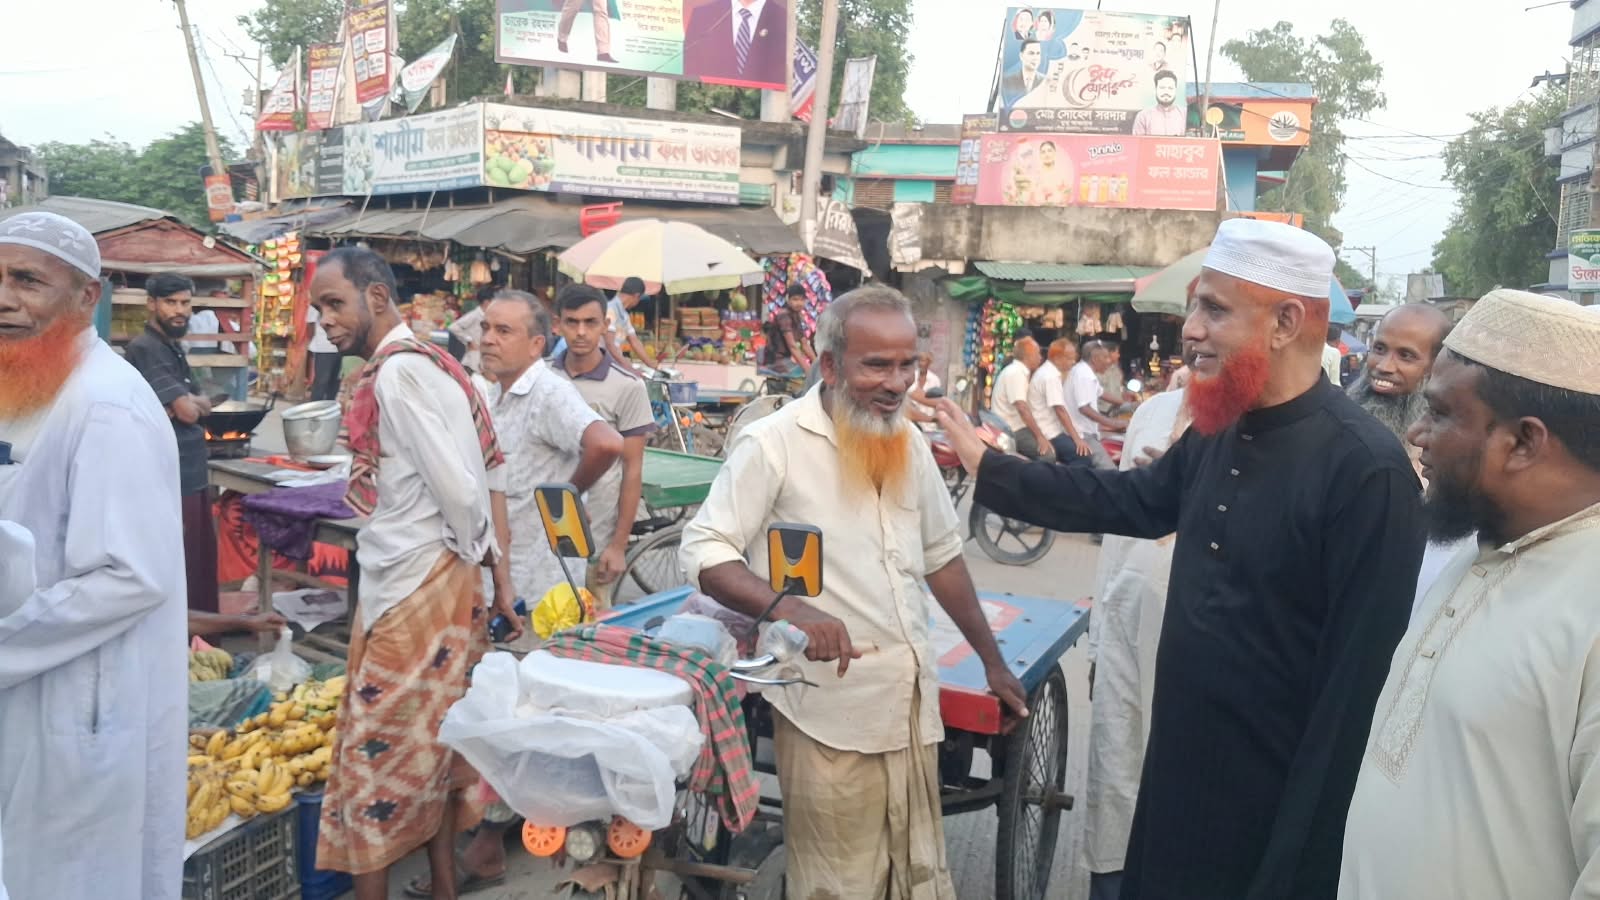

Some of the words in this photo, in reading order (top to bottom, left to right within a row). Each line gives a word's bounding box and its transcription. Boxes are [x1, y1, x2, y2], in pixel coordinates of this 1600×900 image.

[1088, 63, 1118, 82] ঈদ
[1079, 73, 1136, 101] মোবারক
[373, 120, 425, 160] শামীম
[553, 119, 653, 162] শামীম
[657, 142, 687, 163] ফল
[1088, 143, 1122, 159] Drinko
[1148, 166, 1169, 179] ফল
